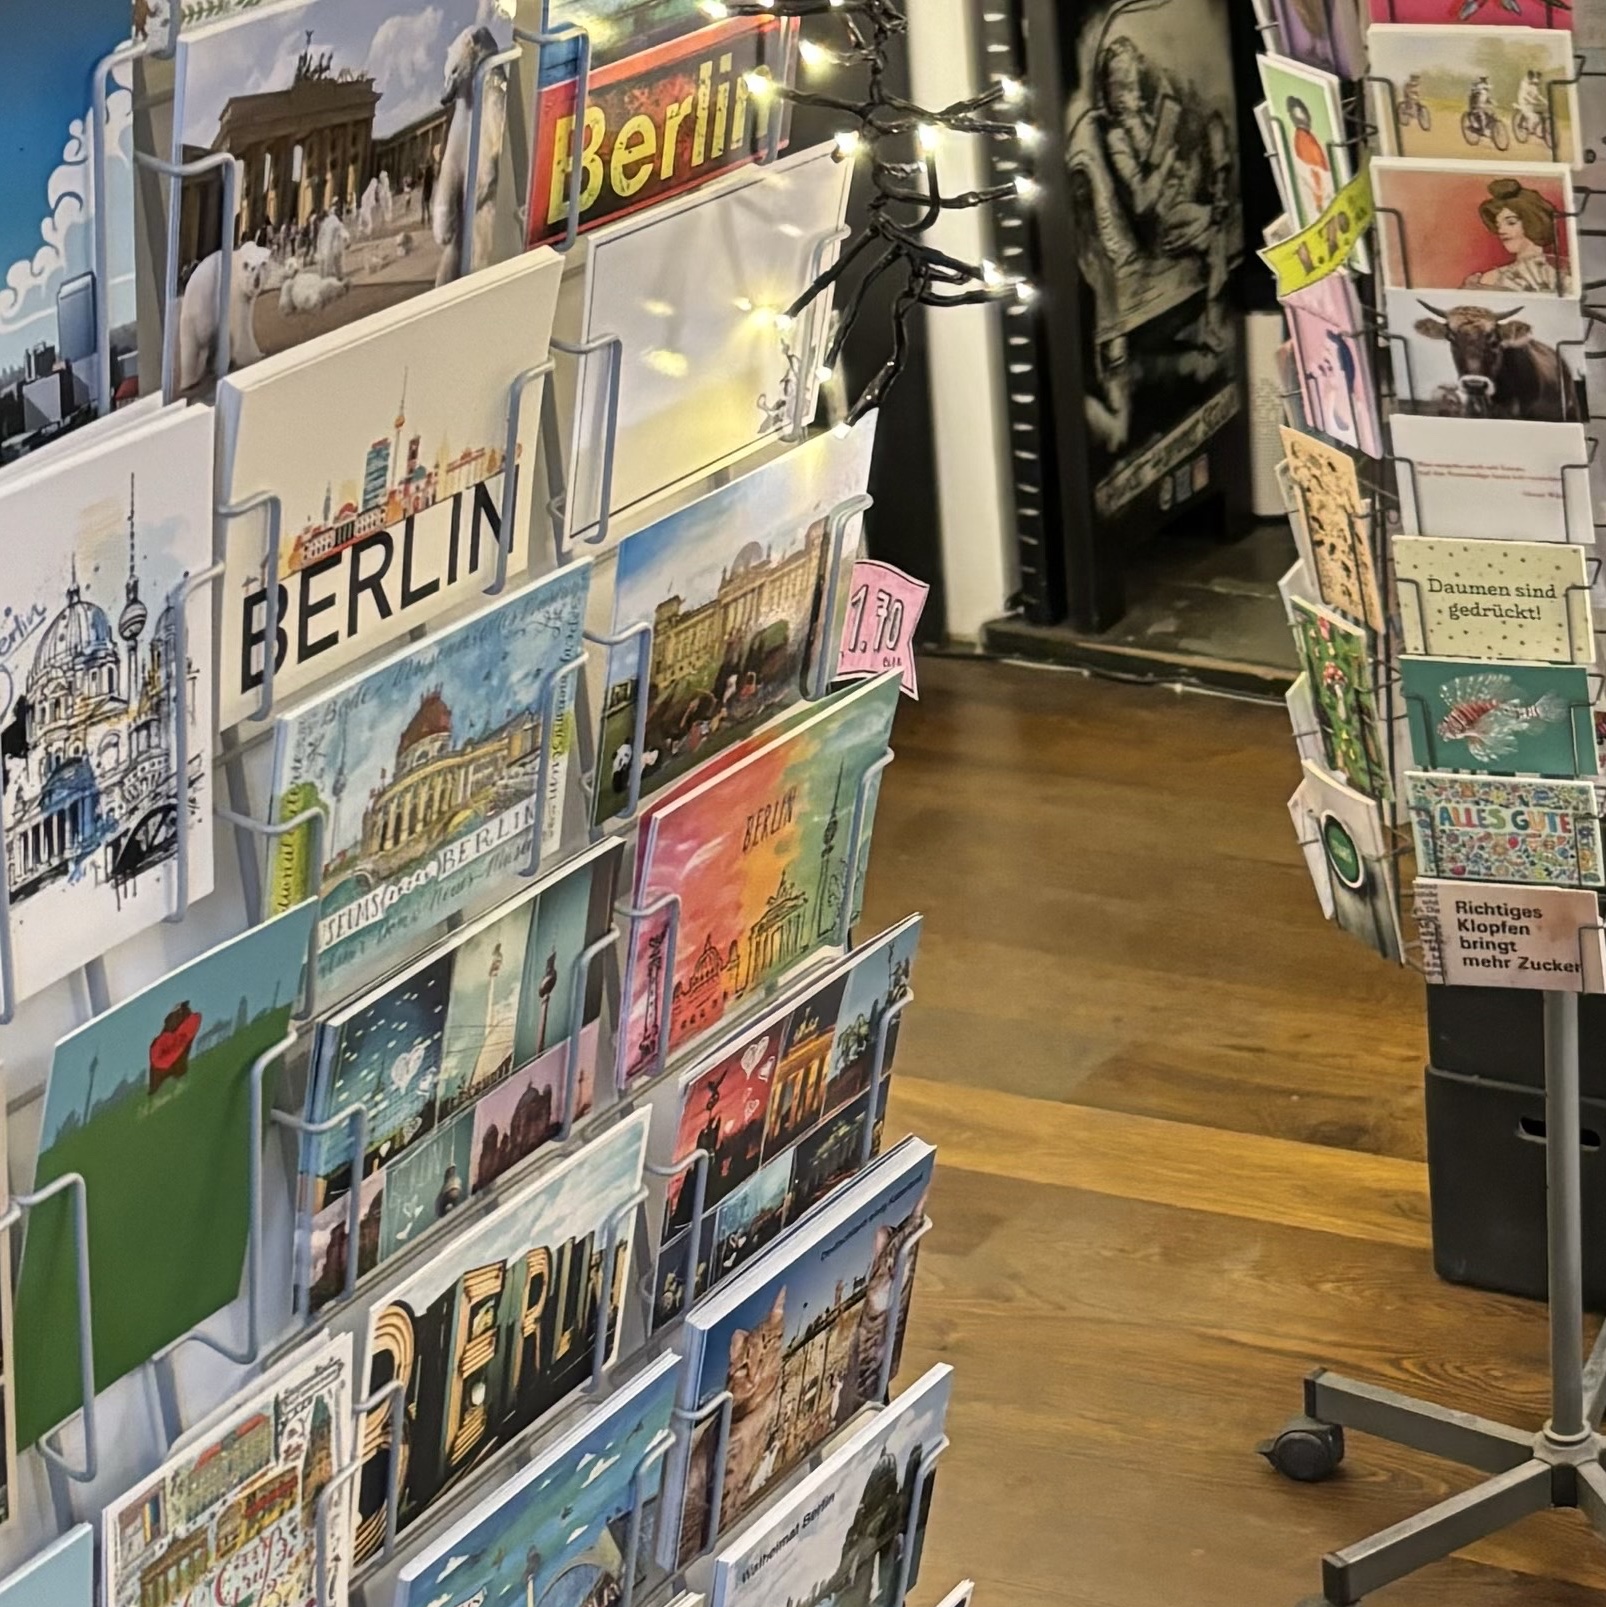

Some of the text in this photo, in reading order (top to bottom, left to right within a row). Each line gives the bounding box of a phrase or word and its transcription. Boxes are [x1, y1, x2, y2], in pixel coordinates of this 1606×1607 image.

[547, 52, 780, 225] Berlin
[240, 466, 521, 696] BERLIN
[1427, 578, 1557, 599] Daumen sind
[848, 583, 903, 654] 1.70
[1448, 600, 1542, 622] gedrückt!
[0, 601, 47, 657] erlin
[742, 785, 799, 855] BERLIN
[1439, 806, 1572, 834] ALLES GUTE
[1455, 900, 1543, 919] Richtiges
[1457, 918, 1531, 937] Klopfen
[1460, 936, 1518, 955] bringt
[1462, 955, 1583, 974] mehr Zucker
